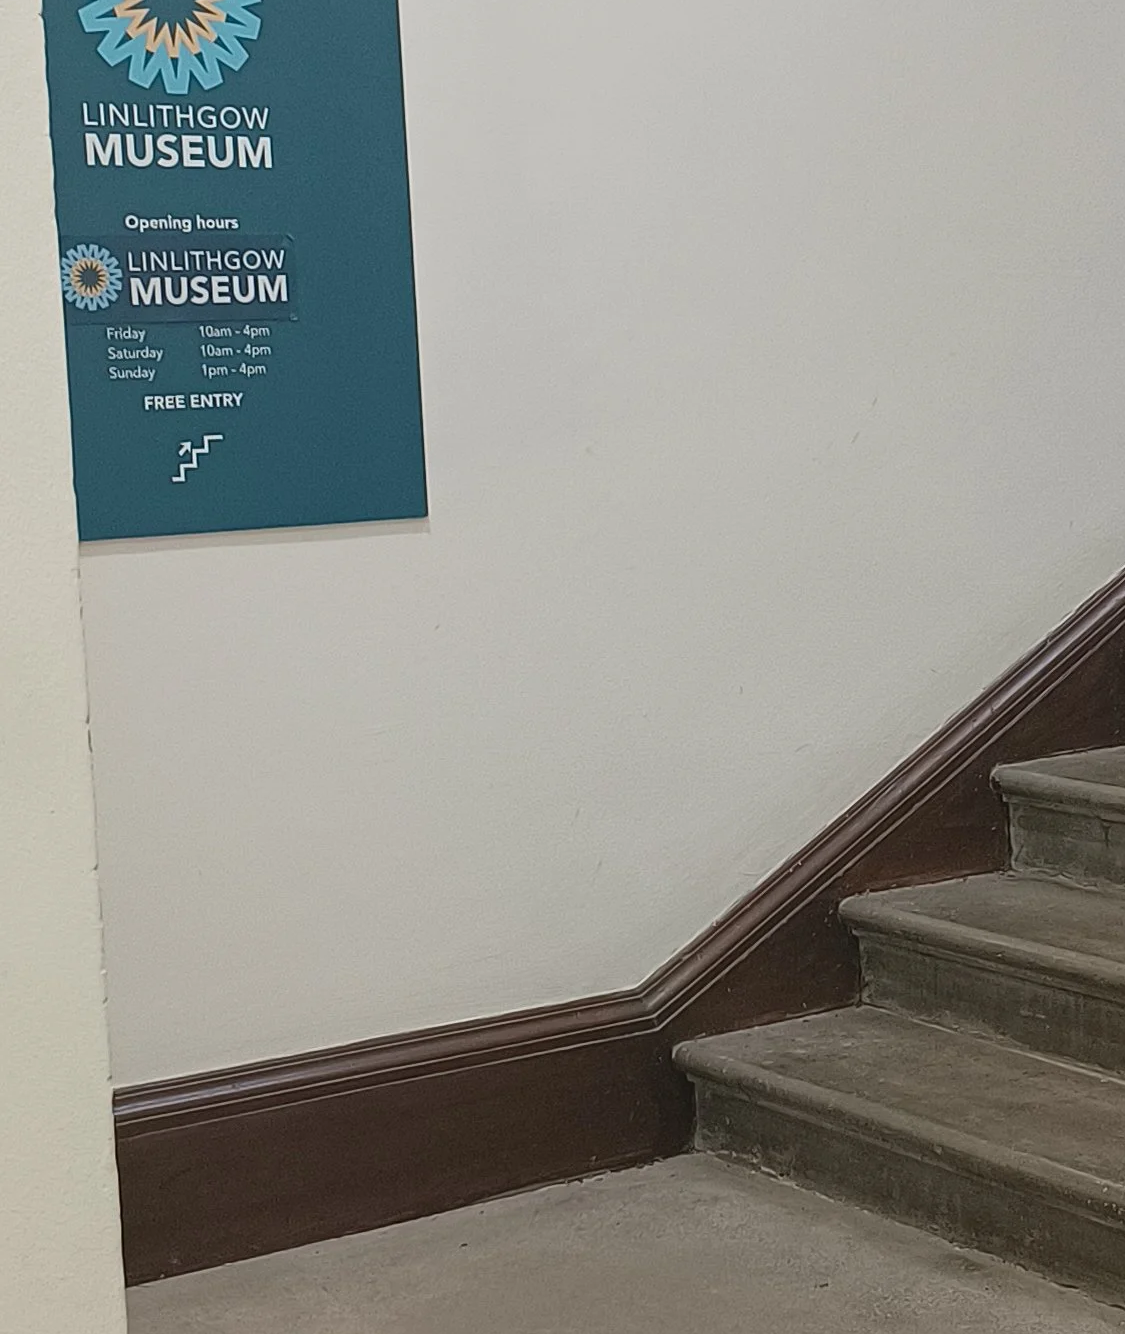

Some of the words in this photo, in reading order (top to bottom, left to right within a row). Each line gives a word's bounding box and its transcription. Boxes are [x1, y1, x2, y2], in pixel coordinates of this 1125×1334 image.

[82, 102, 269, 129] LINLITHGOW
[85, 133, 272, 168] MUSEUM
[125, 215, 192, 232] Opening
[196, 214, 239, 229] hours
[128, 250, 284, 272] LINLITHGOW
[130, 274, 288, 305] MUSEUM
[106, 326, 146, 342] Friday
[199, 326, 232, 337] 10am
[243, 325, 270, 339] 4pm
[108, 346, 163, 361] Saturday
[200, 344, 233, 357] 10am
[244, 344, 271, 358] 4pm
[109, 365, 155, 381] Sunday
[202, 364, 228, 379] 1pm
[239, 363, 266, 377] 4pm
[144, 395, 186, 410] FREE
[190, 393, 243, 408] ENTRY
